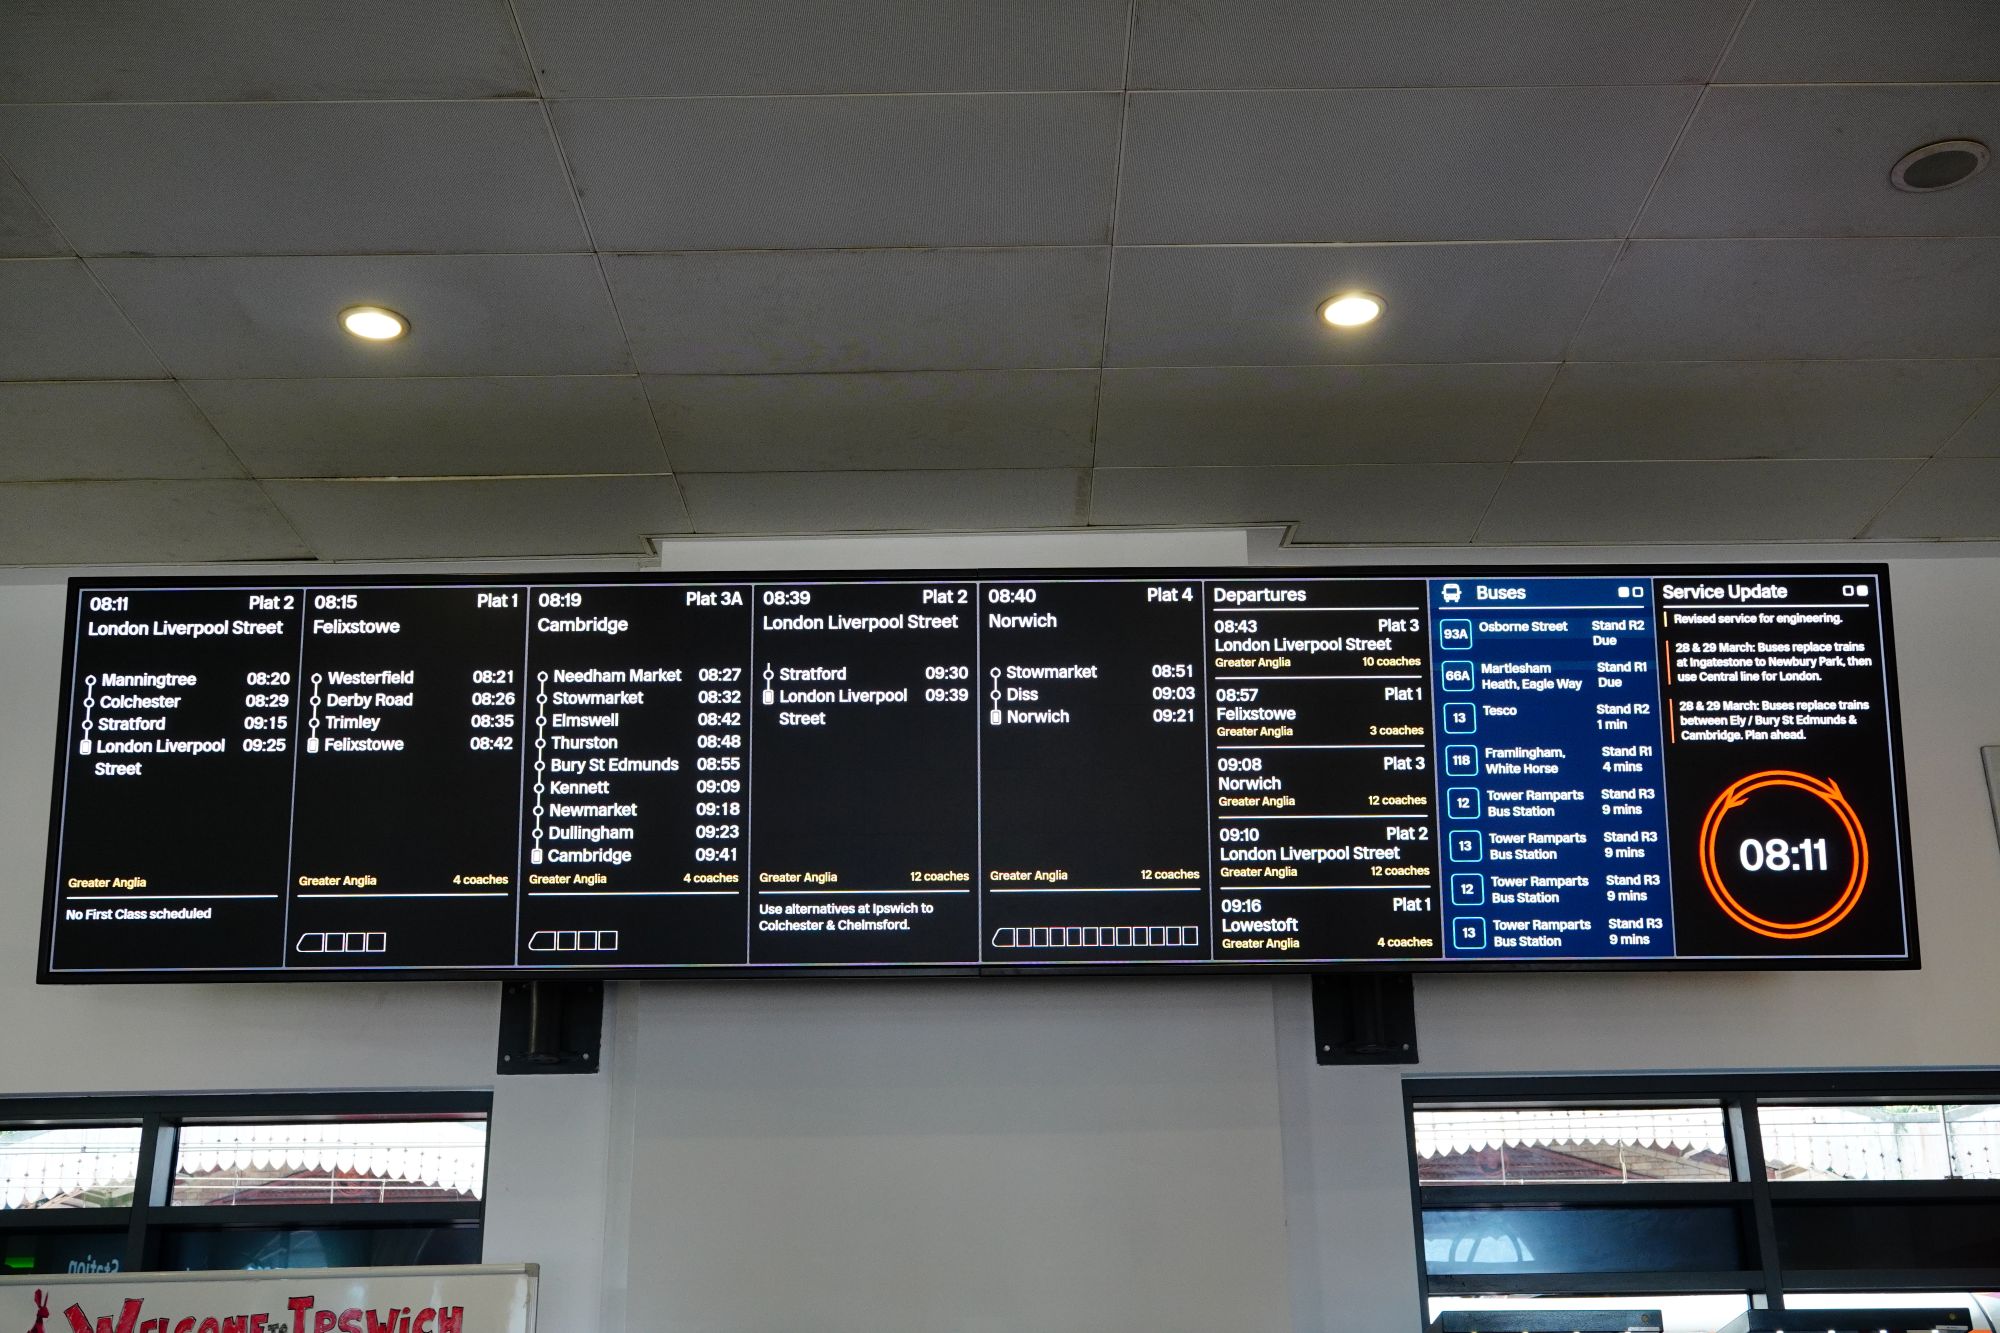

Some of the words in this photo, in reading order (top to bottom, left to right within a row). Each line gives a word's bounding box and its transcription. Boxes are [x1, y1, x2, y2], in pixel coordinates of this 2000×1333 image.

[538, 592, 582, 607] 08:19
[686, 591, 718, 606] Plat
[720, 591, 744, 606] 3A
[763, 590, 811, 605] 08:39
[923, 589, 954, 604] Plat
[957, 589, 968, 604] 2
[988, 588, 1037, 603] 08:40
[1147, 587, 1179, 602] Plat
[1181, 587, 1194, 602] 4
[1213, 587, 1307, 605] Departures
[1476, 585, 1527, 600] Buses
[1662, 584, 1725, 599] Service
[1727, 583, 1788, 602] Update
[89, 596, 129, 611] 08:11
[249, 595, 281, 610] Plat
[283, 595, 295, 610] 2
[314, 594, 358, 609] 08:15
[477, 593, 509, 608] Plat
[511, 593, 518, 607] 1
[763, 614, 824, 630] London
[828, 614, 904, 632] Liverpool
[907, 614, 959, 629] Street
[989, 612, 1057, 628] Norwich
[1591, 620, 1627, 630] Stand
[1628, 620, 1645, 630] R2
[1673, 613, 1717, 624] Revised
[1717, 613, 1758, 624] service
[1758, 613, 1775, 623] for
[1776, 612, 1843, 625] engineering.
[88, 621, 149, 636] London
[153, 620, 229, 638] Liverpool
[232, 620, 284, 635] Street
[313, 619, 401, 634] Felixstowe
[537, 616, 629, 635] Cambridge
[1214, 619, 1258, 633] 08:43
[1378, 618, 1407, 632] Plat
[1409, 618, 1420, 632] 3
[1478, 621, 1530, 632] Osborne
[1531, 621, 1569, 632] Street
[1443, 629, 1468, 639] 93A
[1592, 635, 1618, 646] Due
[1215, 638, 1271, 652] London
[1274, 637, 1343, 654] Liverpool
[1345, 637, 1393, 651] Street
[1675, 643, 1691, 653] 28
[1691, 642, 1701, 653] &
[1702, 642, 1717, 653] 29
[1718, 642, 1756, 652] March:
[1757, 642, 1791, 652] Buses
[1791, 641, 1833, 654] replace
[1833, 641, 1866, 652] trains
[1481, 662, 1552, 674] Martlesham
[1597, 661, 1632, 672] Stand
[1634, 661, 1647, 672] R1
[1676, 658, 1689, 667] at
[1689, 657, 1754, 669] Ingatestone
[1754, 657, 1767, 667] to
[1768, 656, 1818, 669] Newbury
[1818, 656, 1846, 667] Park,
[1846, 655, 1873, 666] then
[327, 670, 414, 685] Westerfield
[472, 670, 514, 684] 08:21
[553, 668, 626, 683] Needham
[629, 668, 682, 682] Market
[698, 668, 742, 682] 08:27
[779, 666, 847, 681] Stratford
[925, 666, 969, 680] 09:30
[1445, 670, 1471, 681] 66A
[1677, 673, 1698, 682] use
[1698, 671, 1739, 682] Central
[1739, 671, 1760, 681] line
[1761, 671, 1778, 681] for
[1779, 670, 1823, 681] London.
[101, 672, 197, 689] Manningtree
[246, 672, 291, 685] 08:20
[1481, 678, 1520, 690] Heath,
[1521, 678, 1555, 691] Eagle
[1556, 678, 1583, 691] Way
[1482, 705, 1518, 716] Tesco
[1596, 703, 1632, 714] Stand
[1633, 704, 1650, 714] R2
[1453, 712, 1466, 723] 13
[1597, 719, 1603, 729] 1
[1604, 718, 1628, 729] min
[1679, 715, 1729, 726] between
[1729, 715, 1747, 728] Ely
[1747, 715, 1753, 726] /
[1754, 715, 1781, 727] Bury
[1781, 715, 1795, 725] St
[1795, 714, 1847, 725] Edmunds
[1848, 714, 1858, 725] &
[1680, 729, 1744, 742] Cambridge.
[1744, 729, 1769, 740] Plan
[1770, 729, 1807, 740] ahead.
[1485, 747, 1566, 760] Framlingham,
[1601, 745, 1637, 757] Stand
[1639, 746, 1653, 756] R1
[551, 758, 587, 775] Bury
[588, 758, 606, 772] St
[608, 757, 680, 772] Edmunds
[696, 757, 741, 771] 08:55
[1452, 755, 1471, 765] 118
[1602, 761, 1612, 772] 4
[1613, 761, 1643, 772] mins
[1485, 763, 1522, 774] White
[1523, 763, 1559, 774] Horse
[1739, 838, 1828, 871] 08:11
[298, 876, 342, 886] Greater
[342, 875, 377, 888] Anglia
[452, 875, 462, 885] 4
[462, 874, 509, 885] coaches
[990, 870, 1033, 881] Greater
[1034, 869, 1068, 883] Anglia
[1140, 869, 1153, 880] 12
[1154, 868, 1200, 879] coaches
[68, 878, 111, 888] Greater
[112, 877, 147, 890] Anglia
[759, 904, 783, 915] Use
[784, 903, 856, 914] alternatives
[857, 903, 871, 914] at
[872, 902, 919, 916] Ipswich
[920, 903, 934, 913] to
[1221, 899, 1262, 913] 09:16
[1393, 897, 1423, 911] Plat
[1424, 897, 1431, 911] 1
[65, 909, 84, 920] No
[85, 908, 114, 920] First
[114, 908, 148, 920] Class
[149, 907, 212, 919] scheduled
[758, 919, 825, 931] Colchester
[825, 920, 836, 930] &
[837, 918, 911, 930] Chelmsford.
[1222, 917, 1299, 932] Lowestoft
[1492, 920, 1531, 930] Tower
[1532, 919, 1592, 932] Ramparts
[1608, 917, 1644, 929] Stand
[1646, 918, 1663, 929] R3
[1462, 927, 1476, 938] 13
[1609, 934, 1618, 945] 9
[1620, 933, 1651, 945] mins
[1222, 938, 1265, 948] Greater
[1265, 937, 1300, 951] Anglia
[1377, 937, 1386, 947] 4
[1387, 936, 1433, 947] coaches
[1494, 936, 1517, 947] Bus
[1518, 935, 1562, 947] Station
